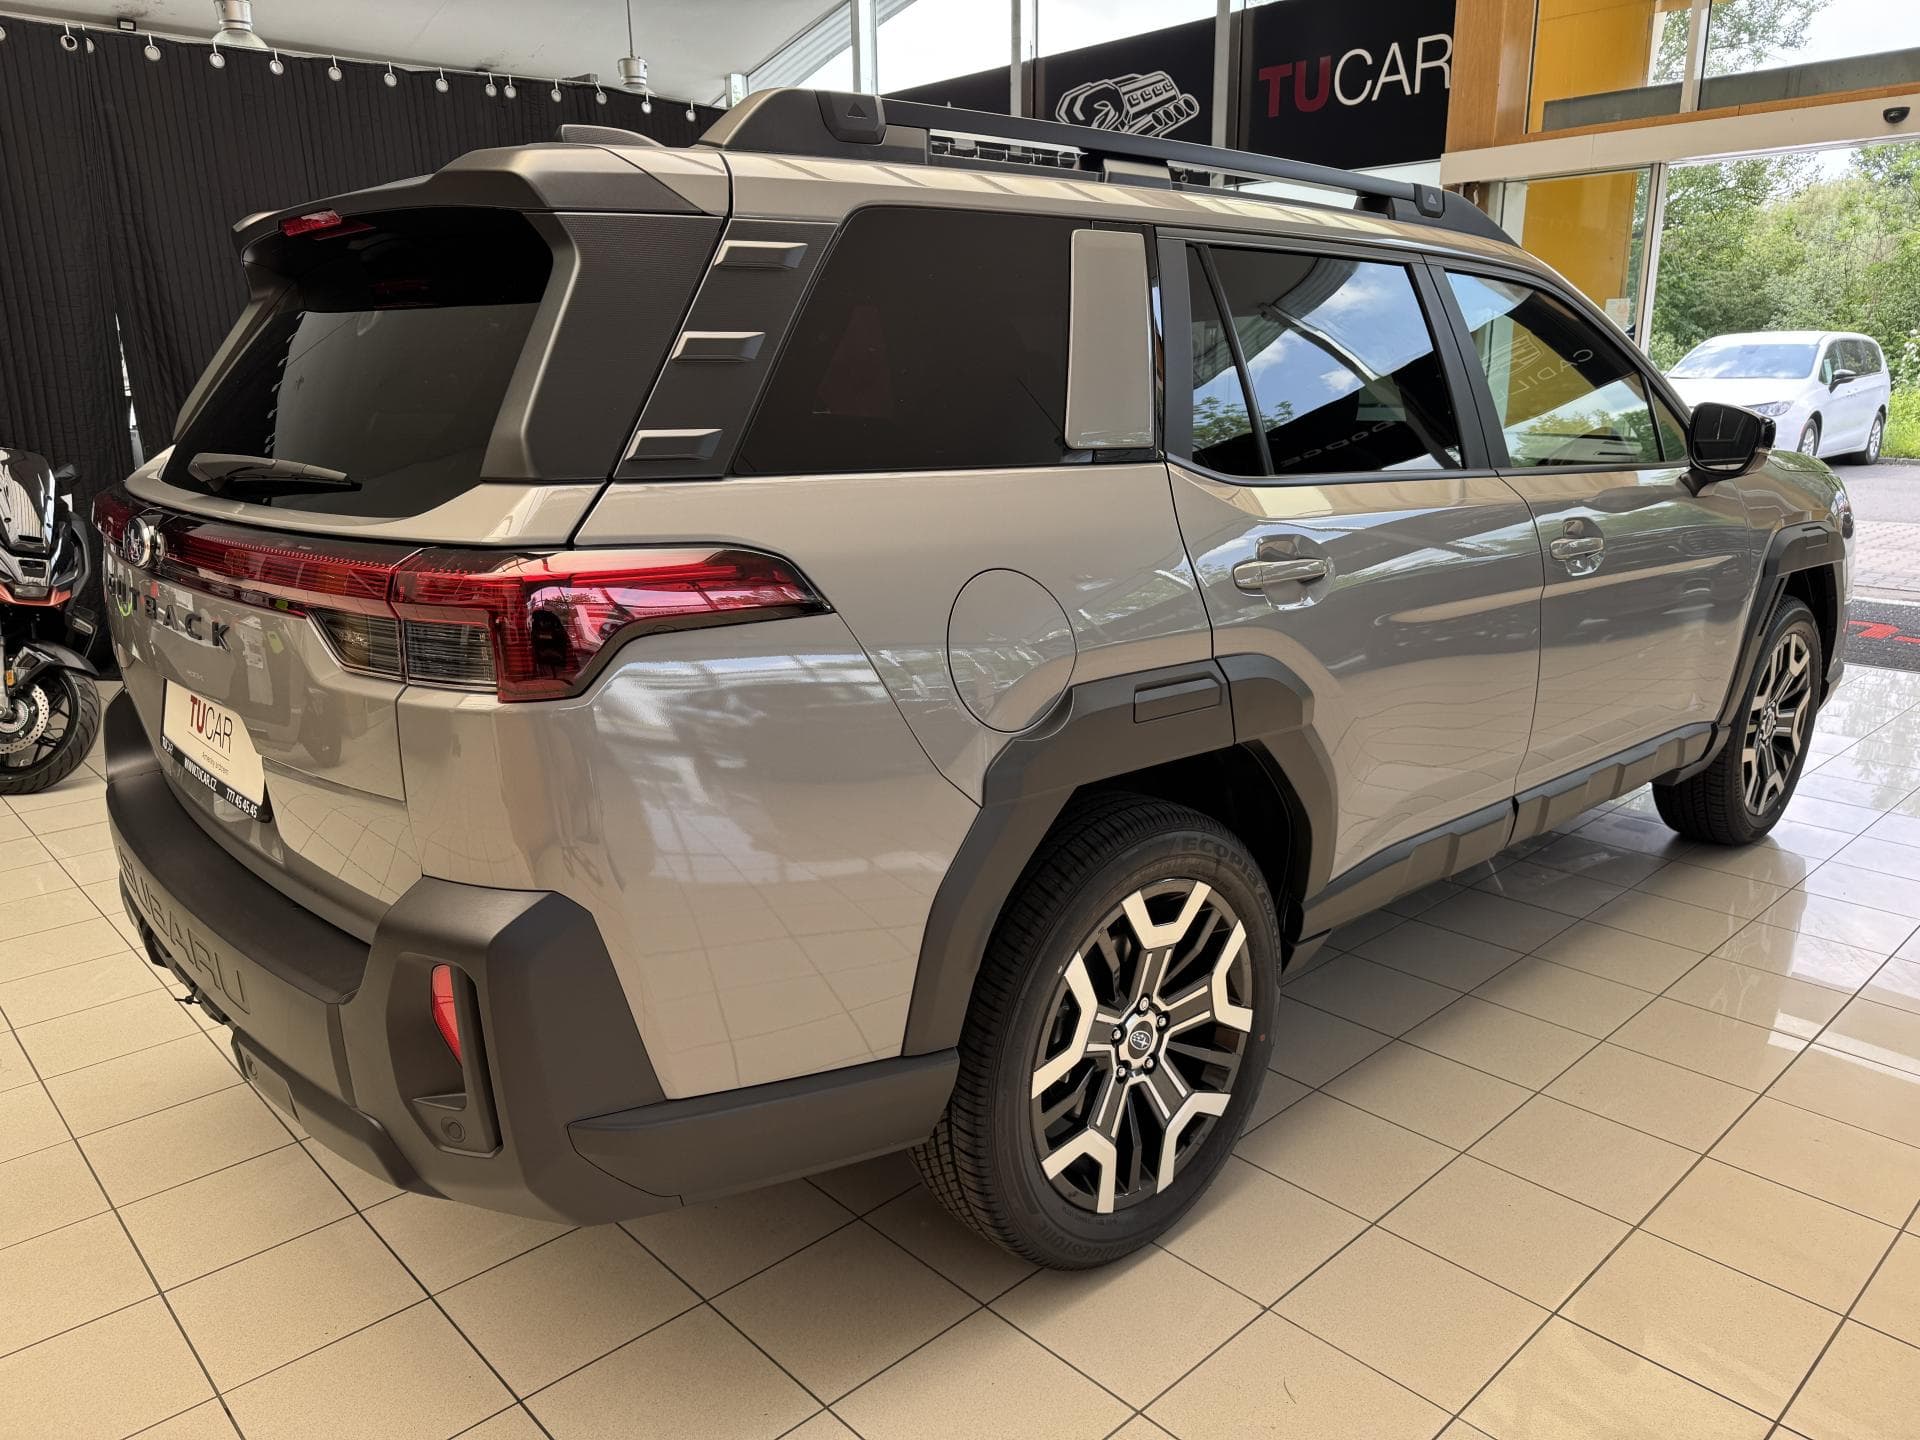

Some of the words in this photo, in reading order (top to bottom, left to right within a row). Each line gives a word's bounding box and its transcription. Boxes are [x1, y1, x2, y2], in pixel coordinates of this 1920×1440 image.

[1259, 34, 1453, 118] TUCAR
[190, 695, 233, 754] TUCAR
[118, 846, 250, 1015] SUBARU
